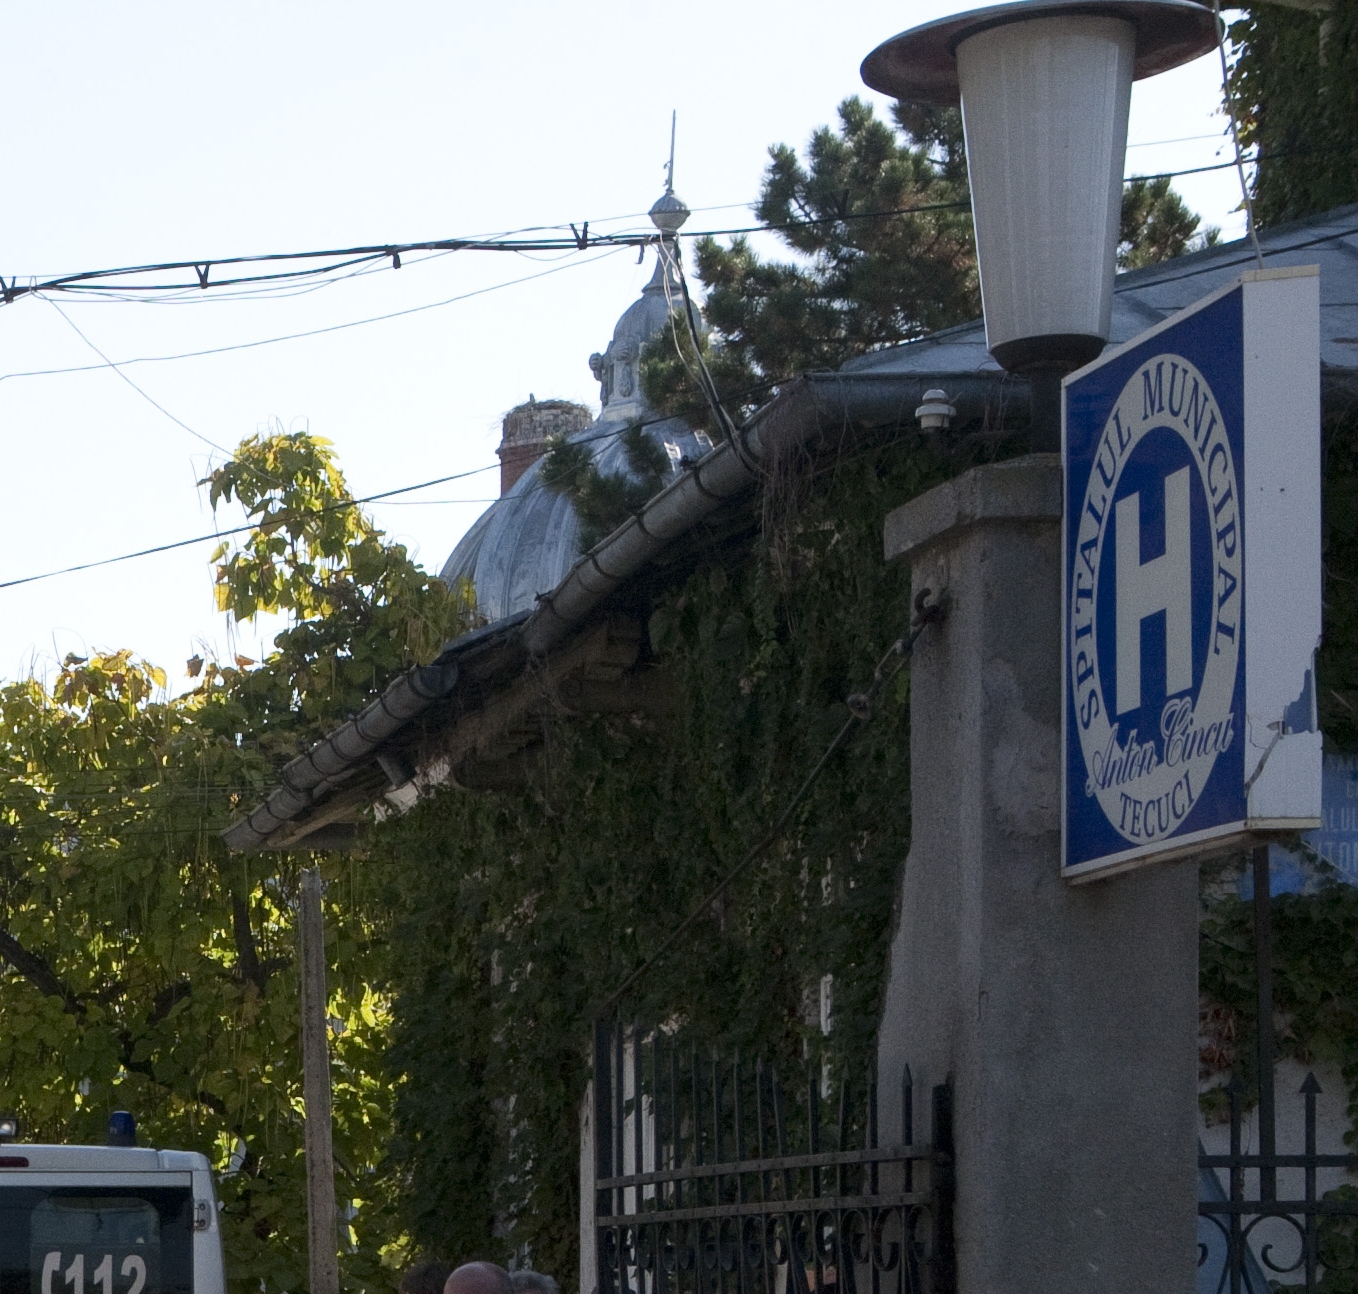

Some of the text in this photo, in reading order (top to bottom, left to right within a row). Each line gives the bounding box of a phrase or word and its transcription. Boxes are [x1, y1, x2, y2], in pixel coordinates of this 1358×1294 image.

[1075, 360, 1237, 731] SPITALUL MUNICIPAL
[1114, 464, 1193, 717] H
[1085, 696, 1235, 798] Anton Cincu
[1118, 769, 1195, 838] TECUCI
